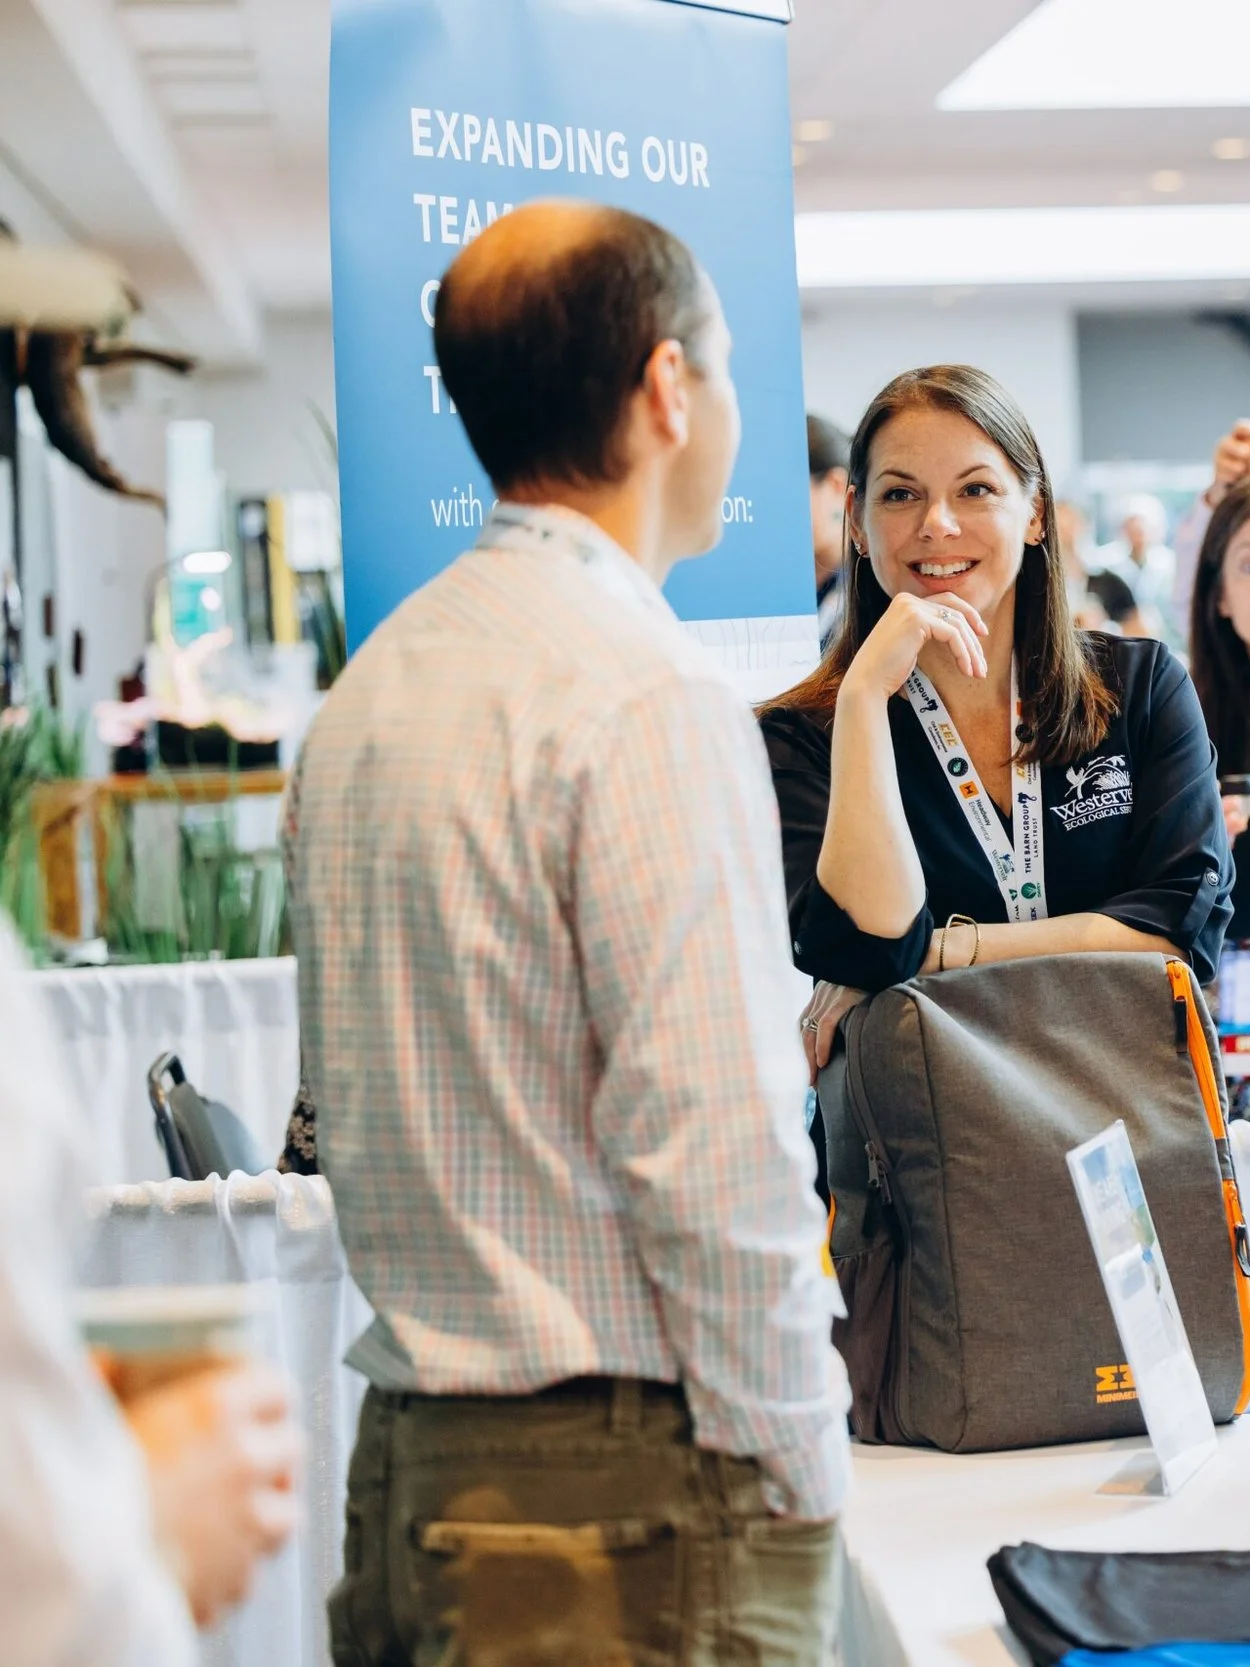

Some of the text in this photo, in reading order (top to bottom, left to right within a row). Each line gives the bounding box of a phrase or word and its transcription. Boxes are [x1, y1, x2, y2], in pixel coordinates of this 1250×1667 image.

[410, 106, 710, 188] EXPANDING OUR
[431, 483, 482, 527] with
[1065, 807, 1120, 831] ECOLOGICAL
